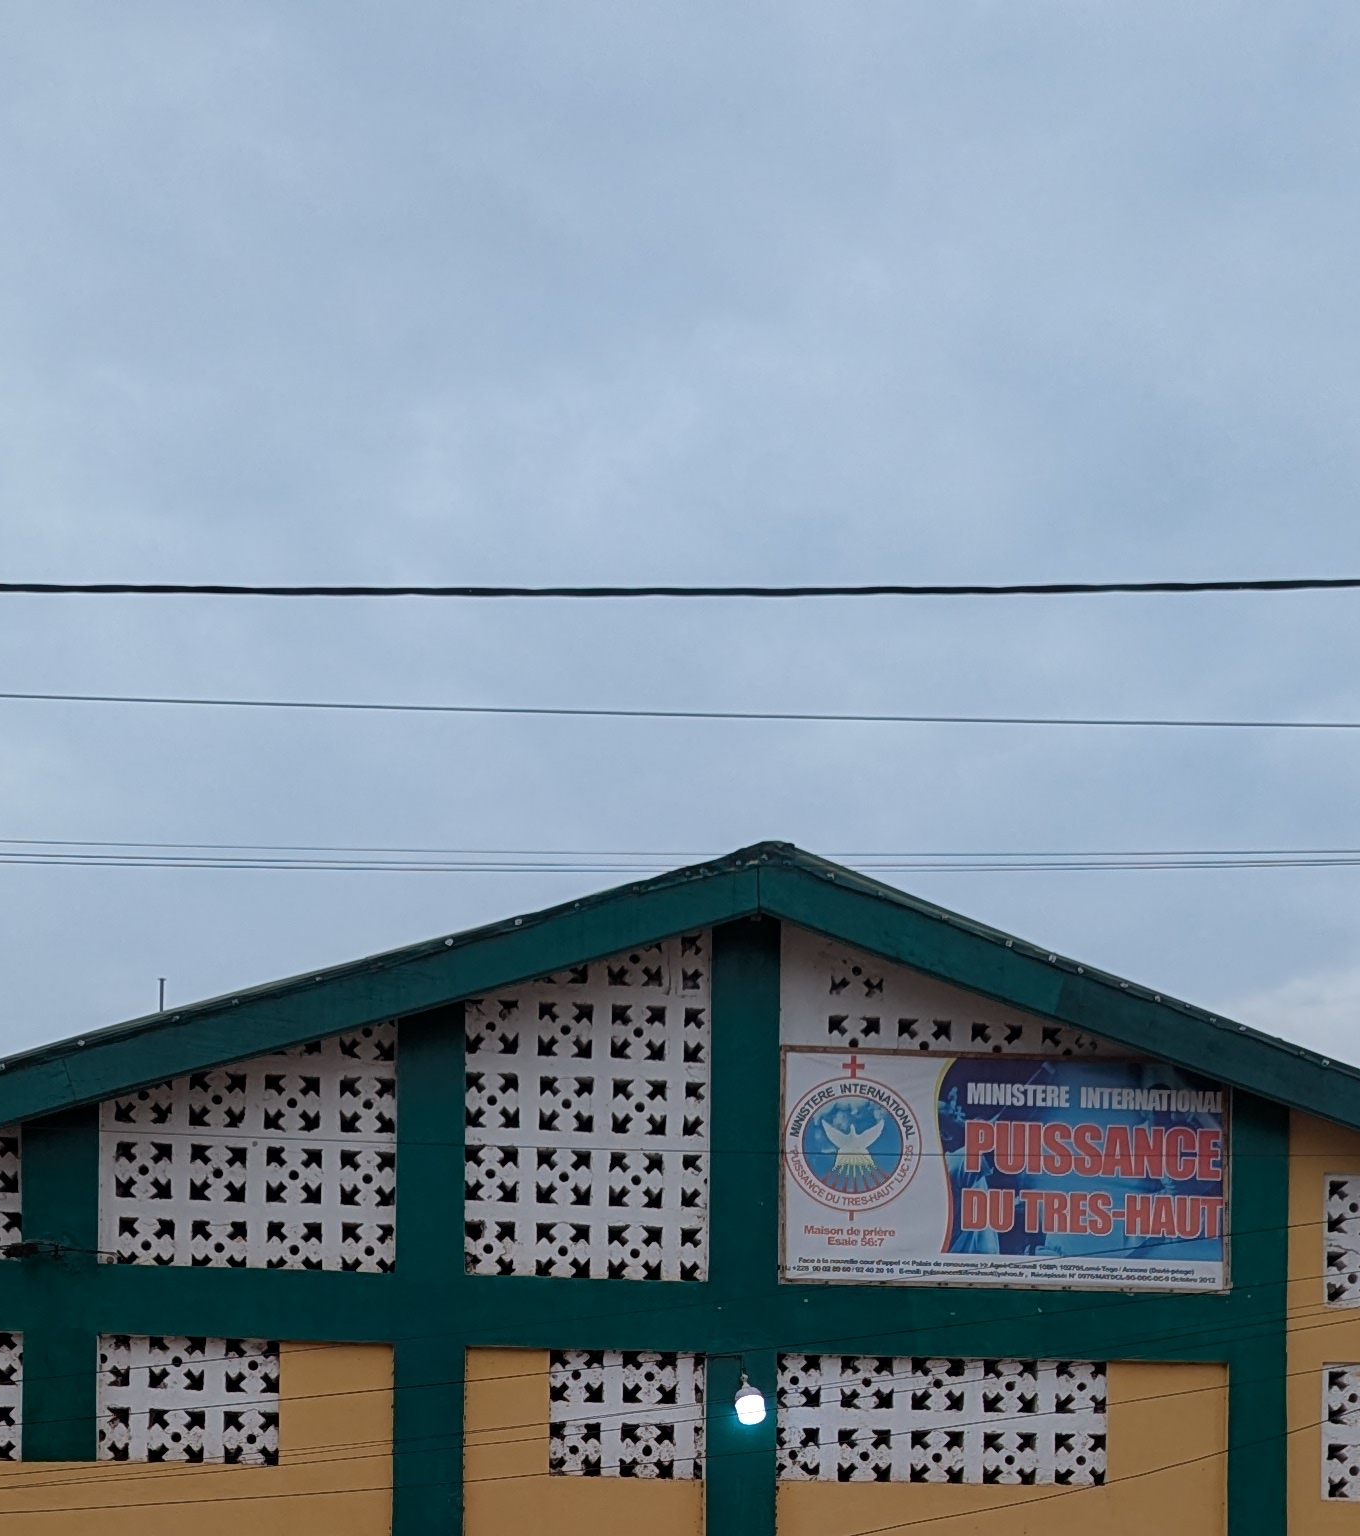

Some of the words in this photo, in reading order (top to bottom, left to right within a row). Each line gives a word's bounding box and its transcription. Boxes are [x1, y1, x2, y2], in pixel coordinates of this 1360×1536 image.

[790, 1086, 836, 1138] MINISTERE
[840, 1083, 916, 1141] INTERNATIONAL
[967, 1082, 1070, 1107] MINISTERE
[965, 1119, 1222, 1181] PUISSANCE
[825, 1193, 840, 1204] DU
[894, 1164, 910, 1184] LUC
[804, 1225, 844, 1235] Maison
[846, 1227, 861, 1236] de
[863, 1228, 896, 1239] prière
[961, 1187, 1015, 1233] DU
[1020, 1190, 1223, 1239] TRES-HAUT
[860, 1238, 885, 1247] 56:7
